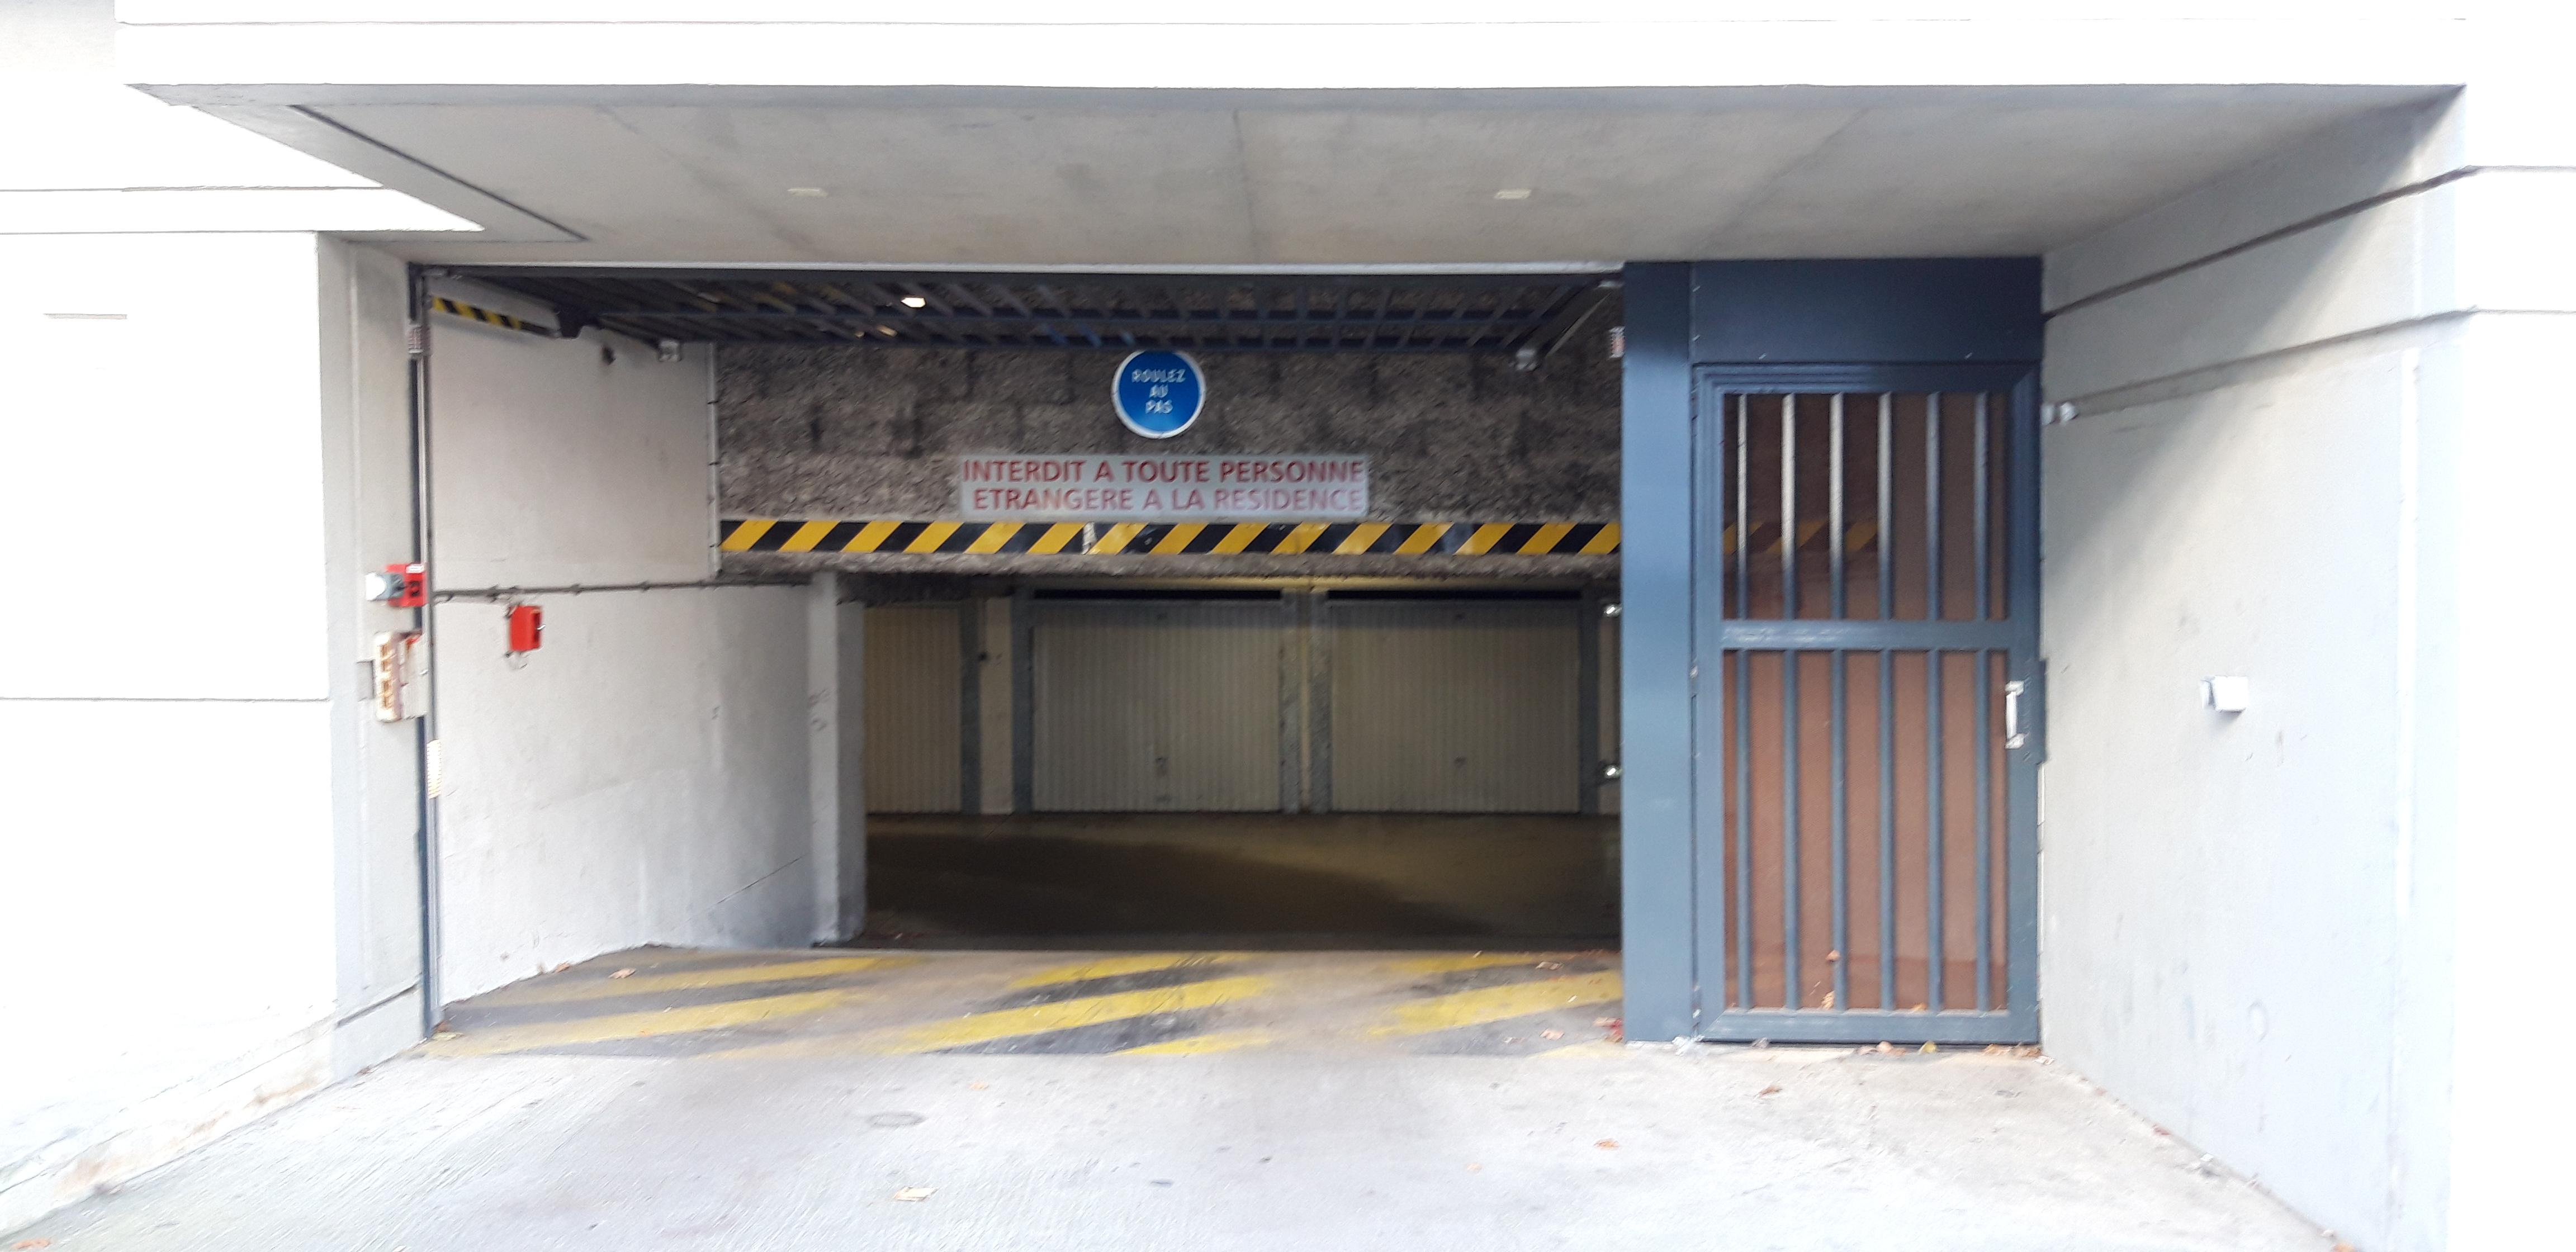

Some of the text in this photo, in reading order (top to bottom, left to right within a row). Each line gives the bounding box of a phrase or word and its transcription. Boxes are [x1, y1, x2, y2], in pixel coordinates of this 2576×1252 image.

[1131, 369, 1186, 382] ROULEZ
[1149, 384, 1168, 398] AU
[1145, 400, 1173, 414] PAS
[963, 459, 1365, 483] INTERDIT A TOUTE PERSONNE
[973, 487, 1365, 511] ETRANGERE A LA RESIDENCE
